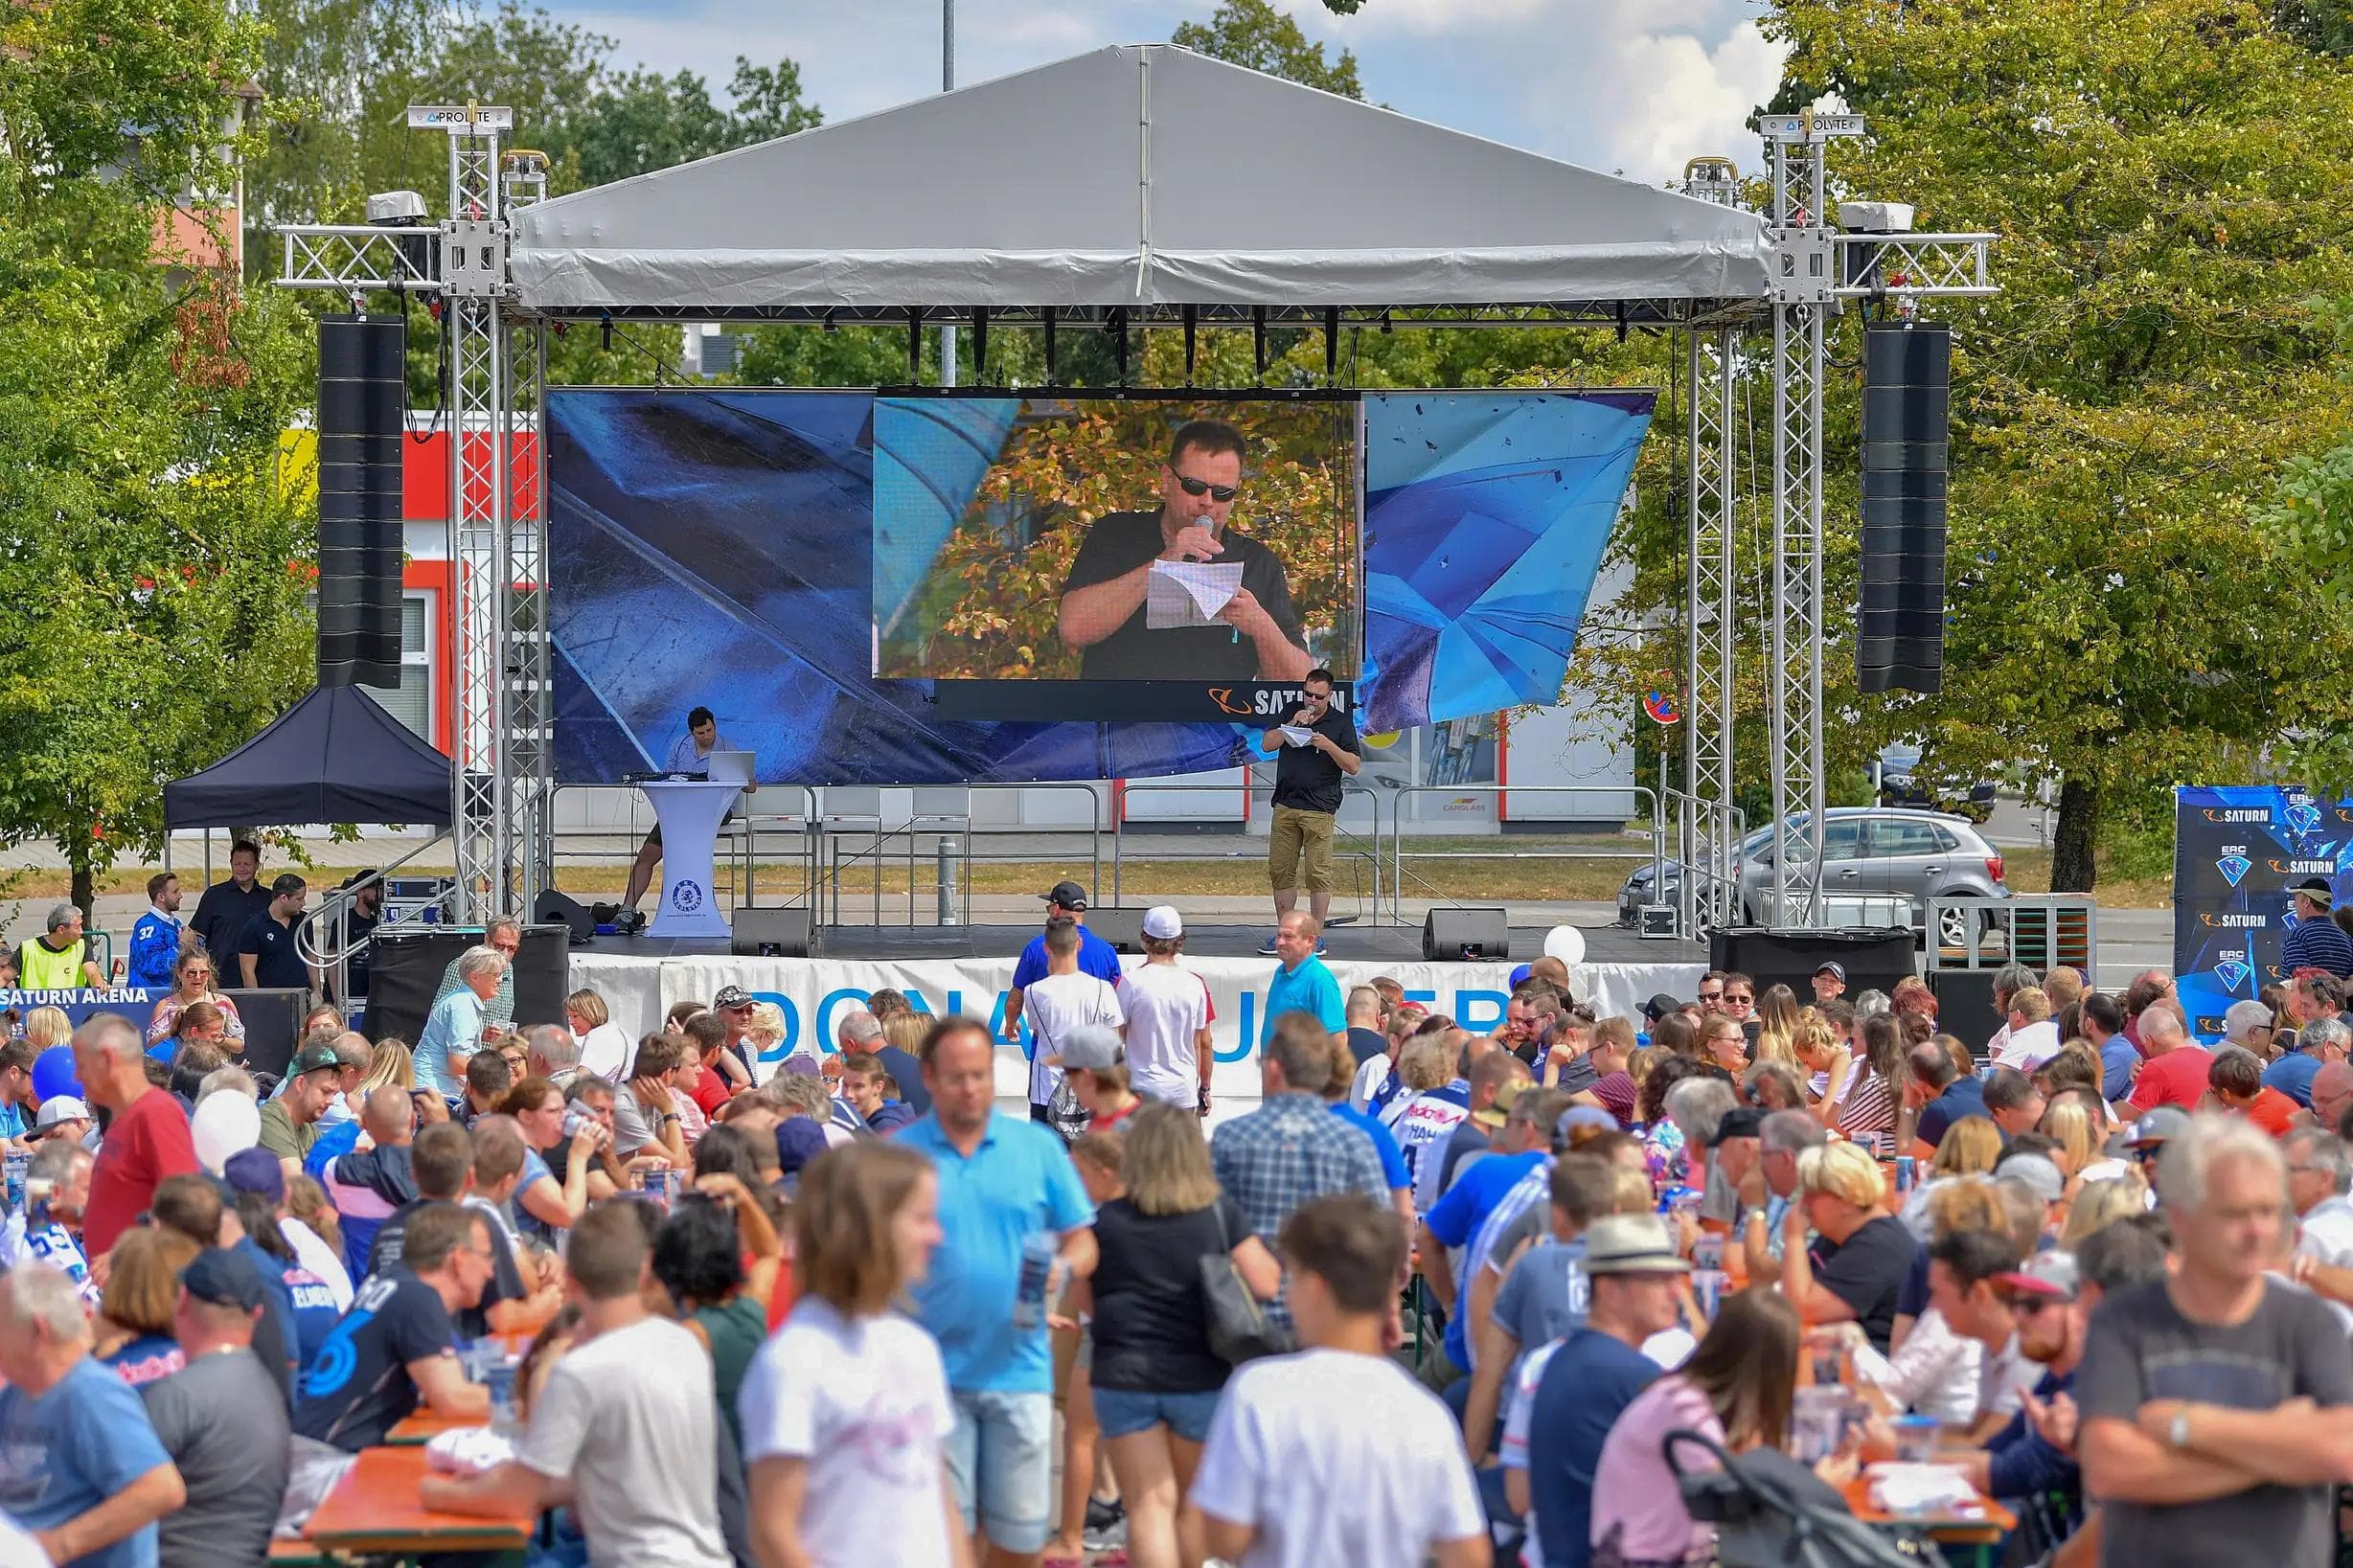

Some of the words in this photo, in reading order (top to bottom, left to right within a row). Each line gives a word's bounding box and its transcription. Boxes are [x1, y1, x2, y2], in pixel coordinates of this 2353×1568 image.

[1798, 120, 1847, 130] POLYTE
[1255, 690, 1344, 715] SATN
[2224, 809, 2268, 822] SATURN
[2222, 845, 2247, 853] ERC
[2290, 860, 2334, 874] SATURN
[2222, 915, 2266, 927] SATURN
[139, 925, 154, 941] 37
[0, 989, 77, 1005] SATURN
[81, 988, 148, 1004] ARENA
